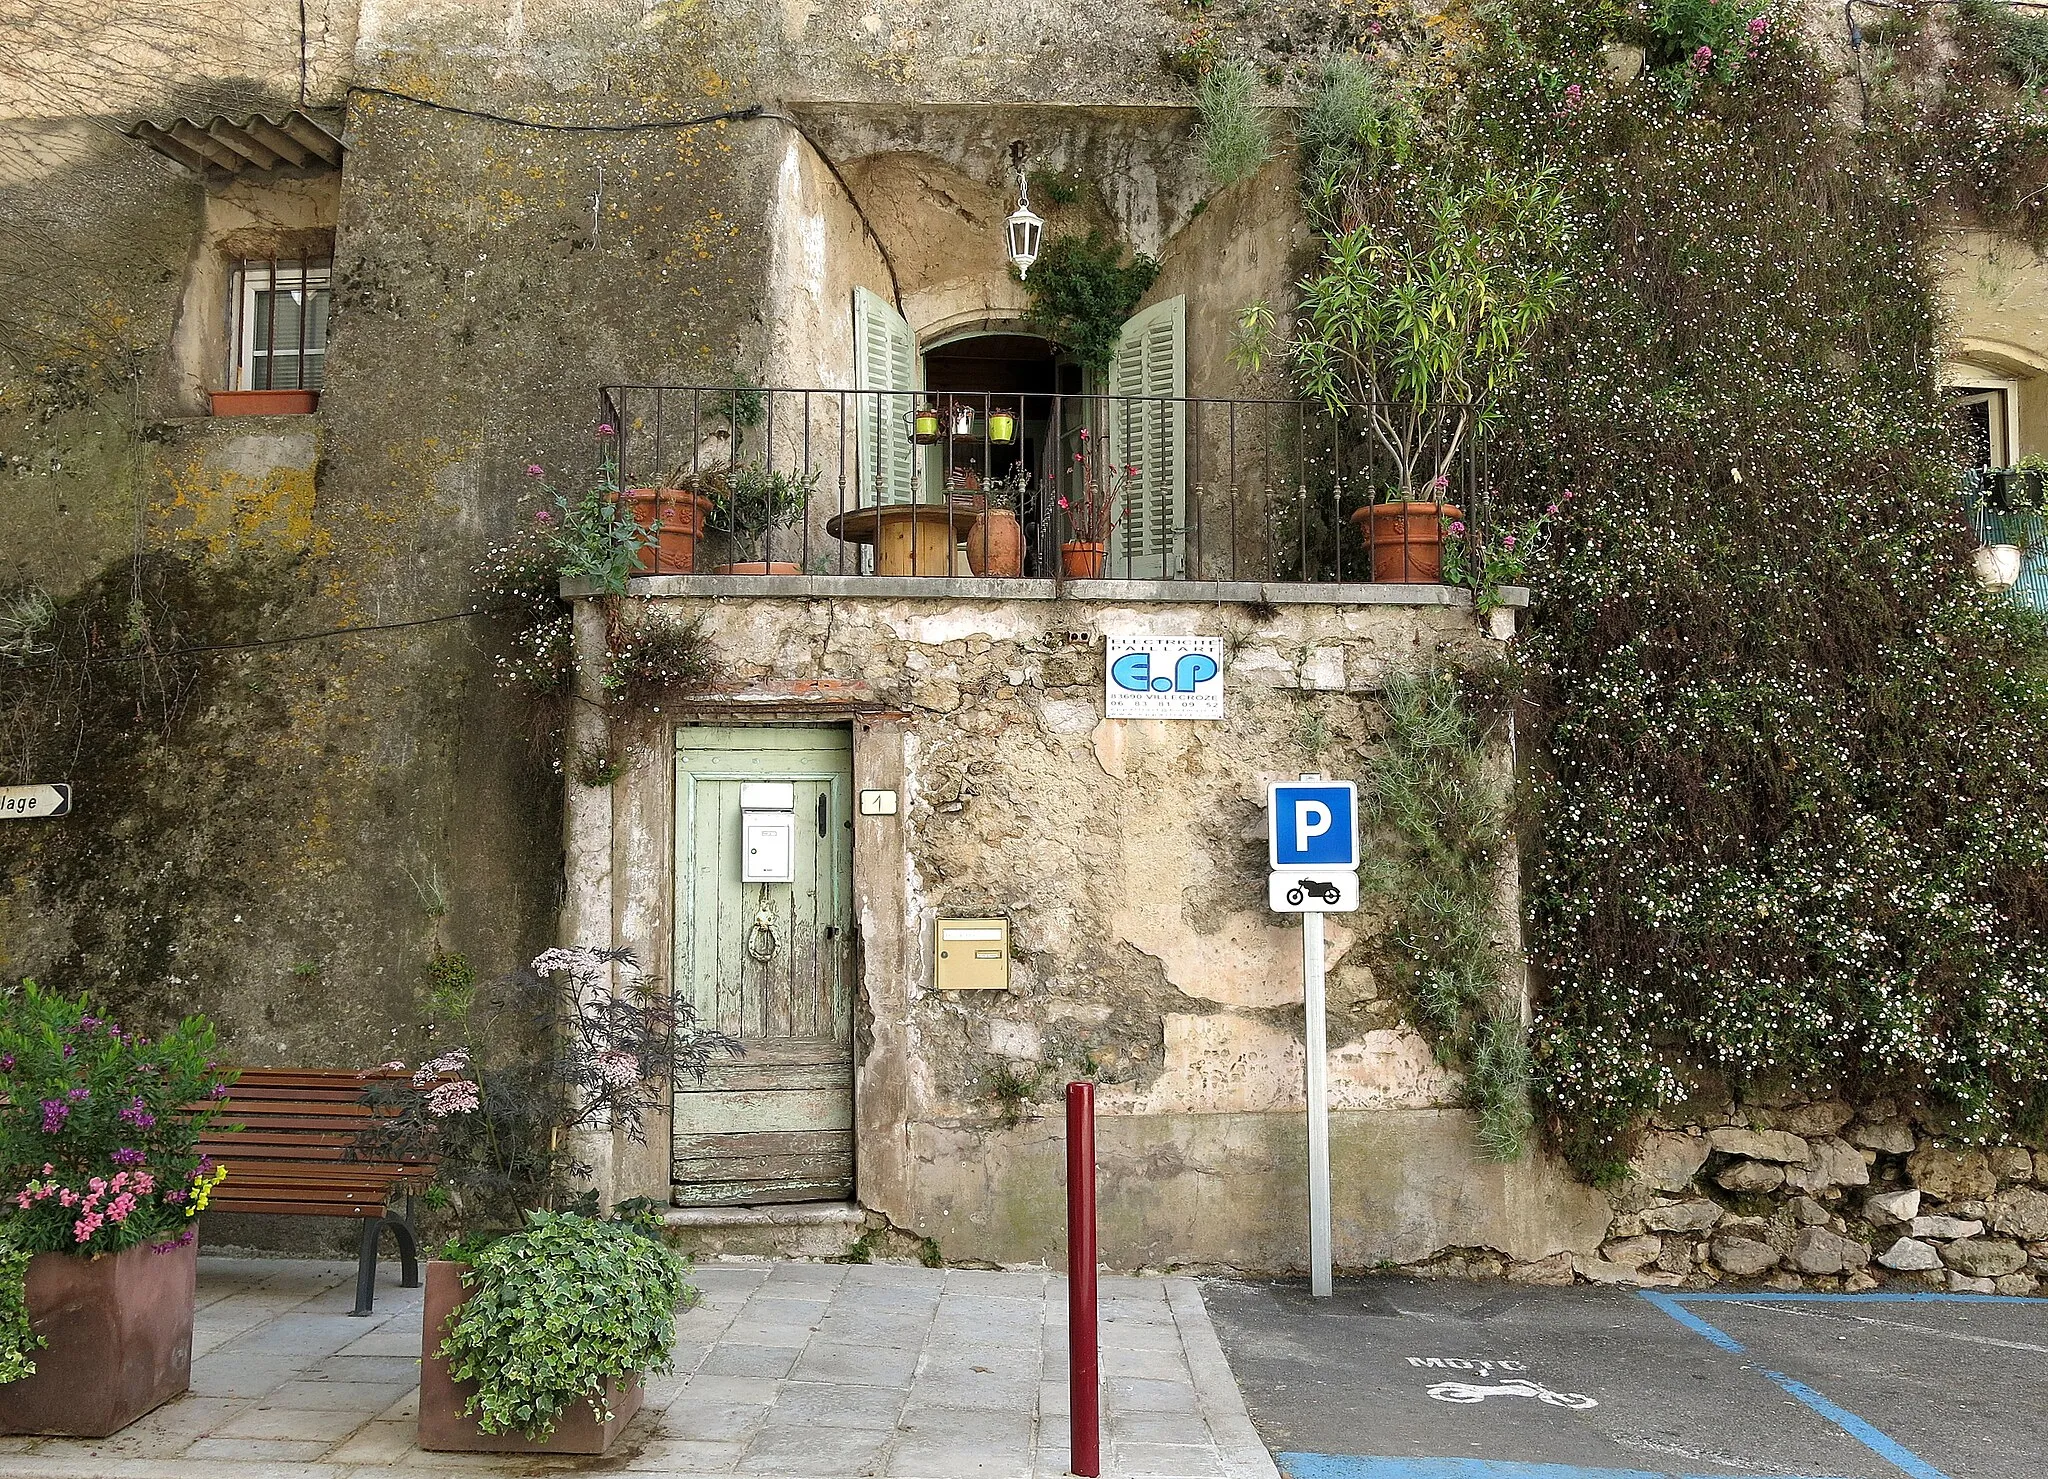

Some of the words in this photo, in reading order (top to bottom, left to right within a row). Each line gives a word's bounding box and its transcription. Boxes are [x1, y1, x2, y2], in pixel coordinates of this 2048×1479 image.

[1111, 652, 1218, 692] E.P
[872, 794, 882, 812] 1
[1295, 800, 1332, 852] P
